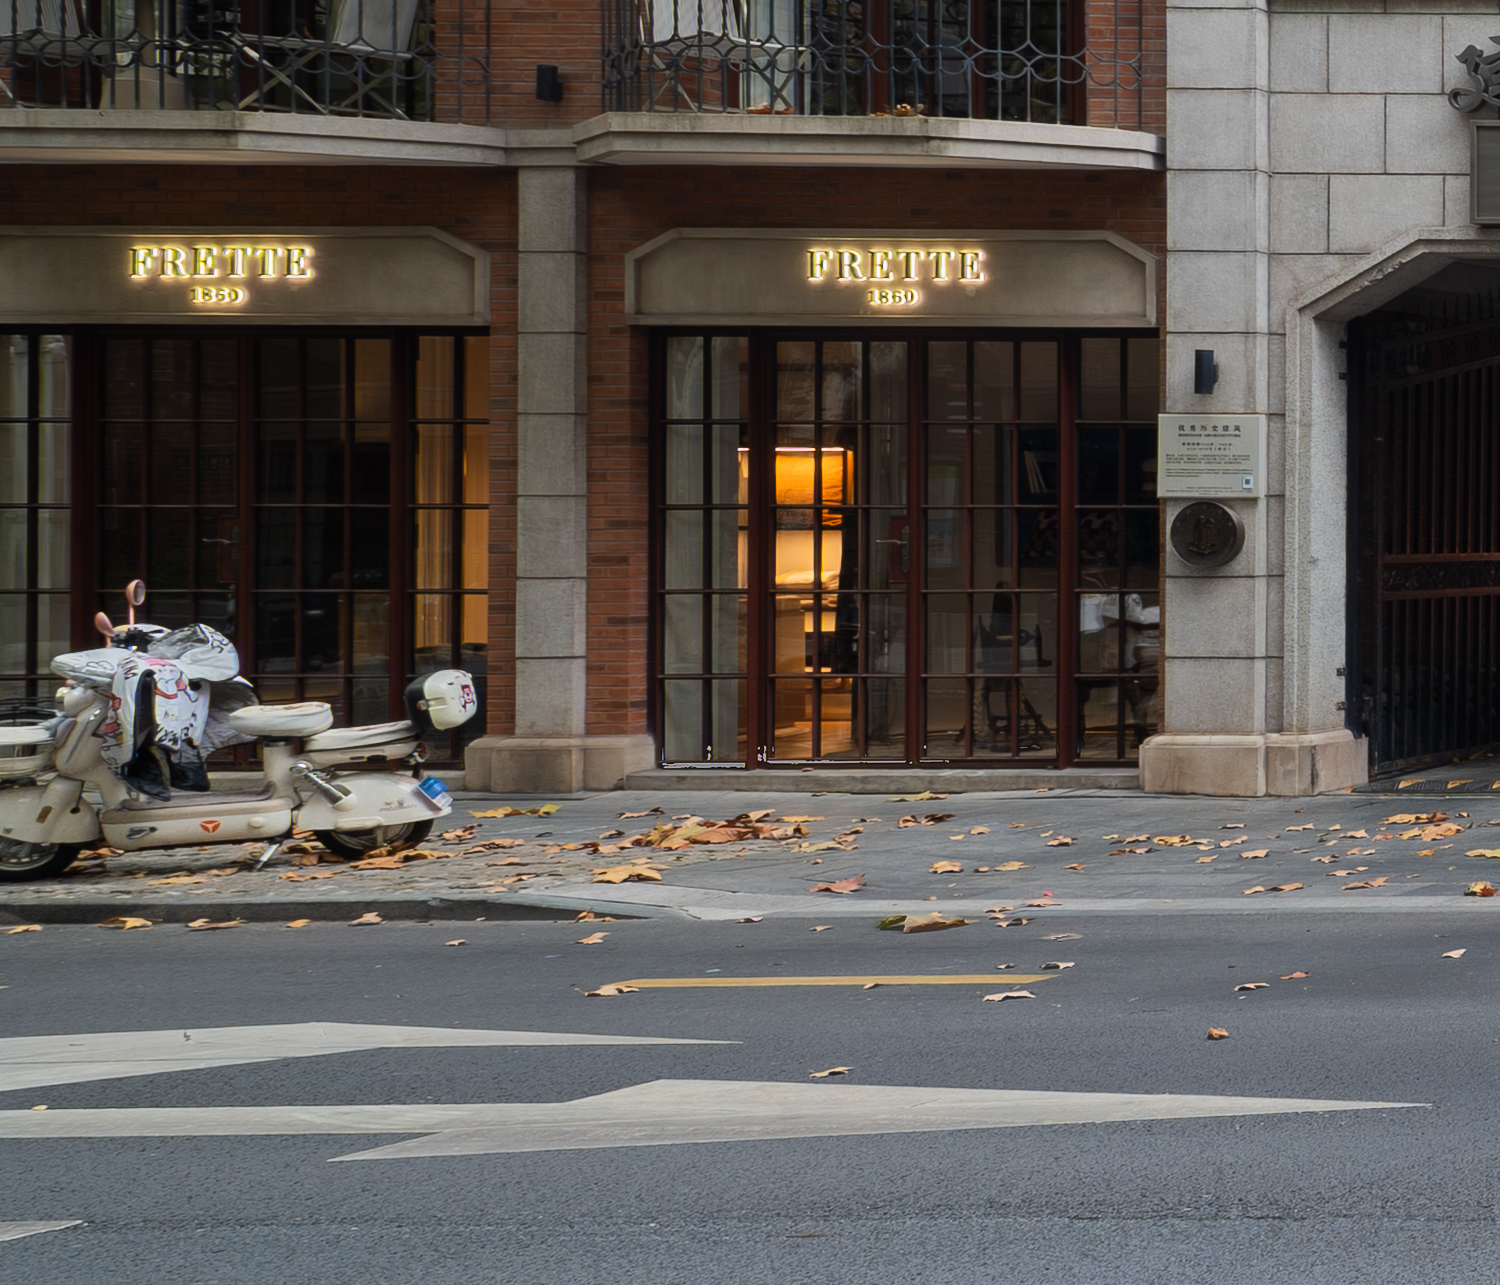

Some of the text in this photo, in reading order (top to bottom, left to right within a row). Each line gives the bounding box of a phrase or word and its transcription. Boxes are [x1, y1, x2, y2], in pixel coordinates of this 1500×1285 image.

[129, 245, 314, 279] FRETTE
[807, 248, 986, 282] FRETTE
[867, 288, 919, 306] 1860
